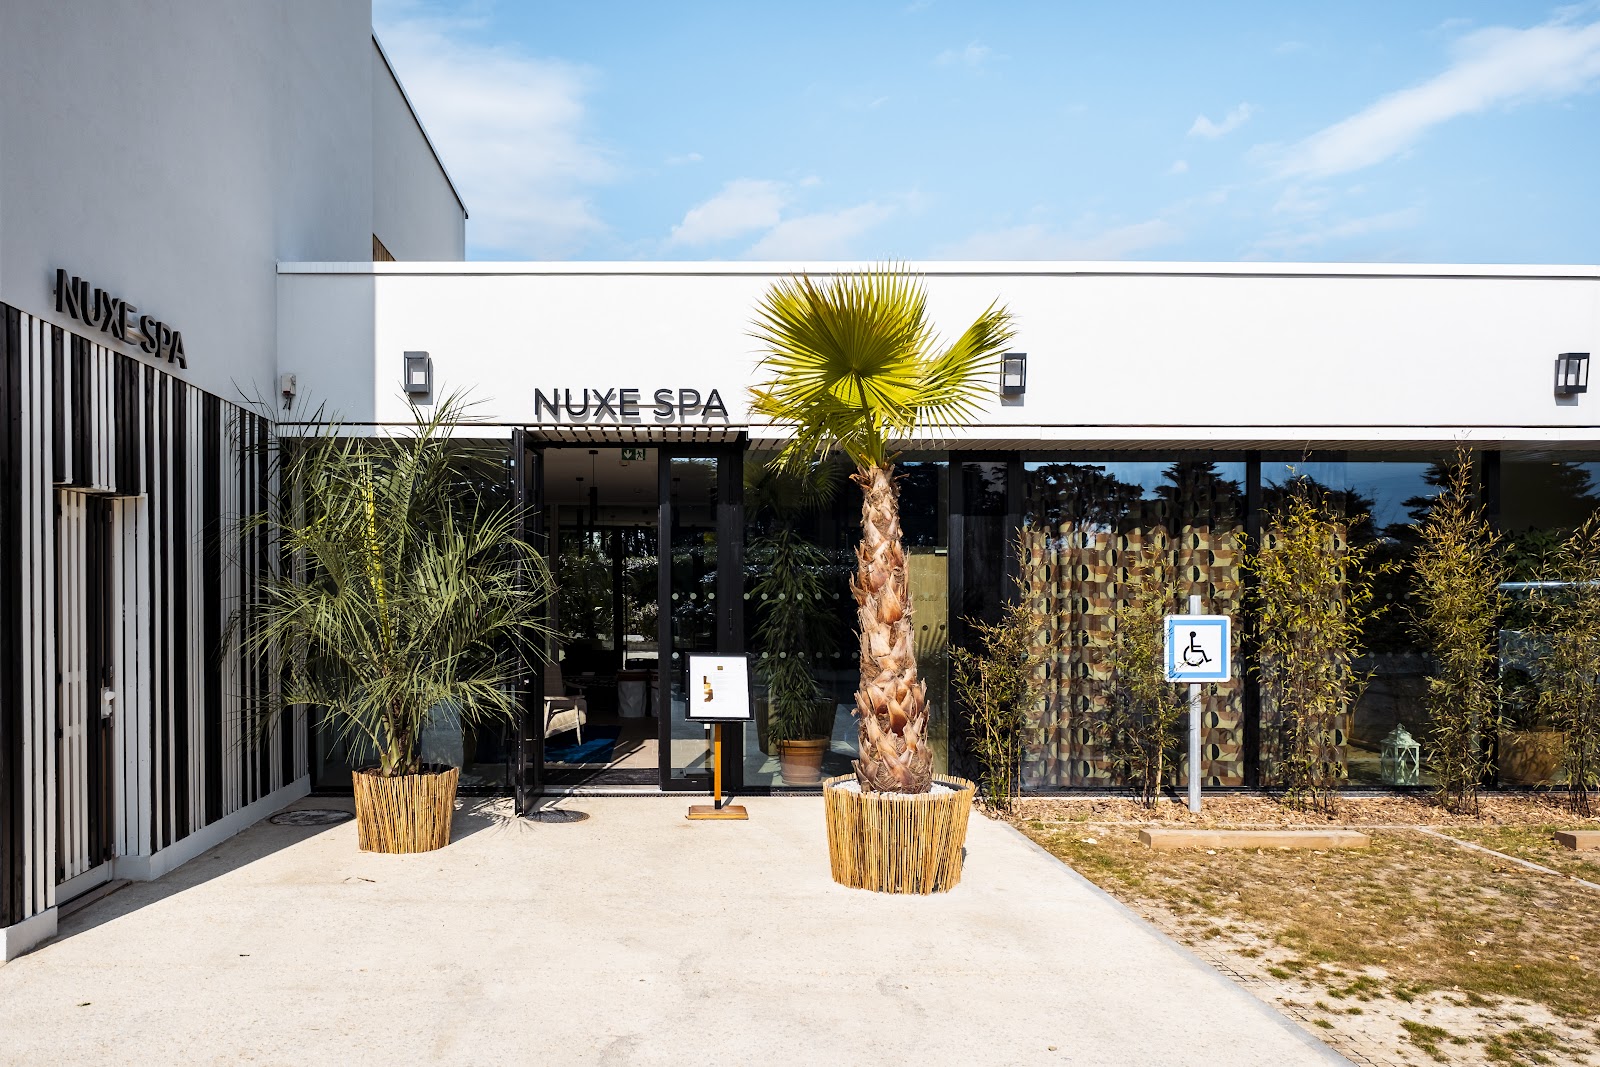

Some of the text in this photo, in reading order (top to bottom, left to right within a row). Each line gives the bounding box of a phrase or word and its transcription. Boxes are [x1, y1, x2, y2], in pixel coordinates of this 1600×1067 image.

[55, 268, 187, 369] NUXE SPA
[534, 388, 729, 417] NUXE SPA
